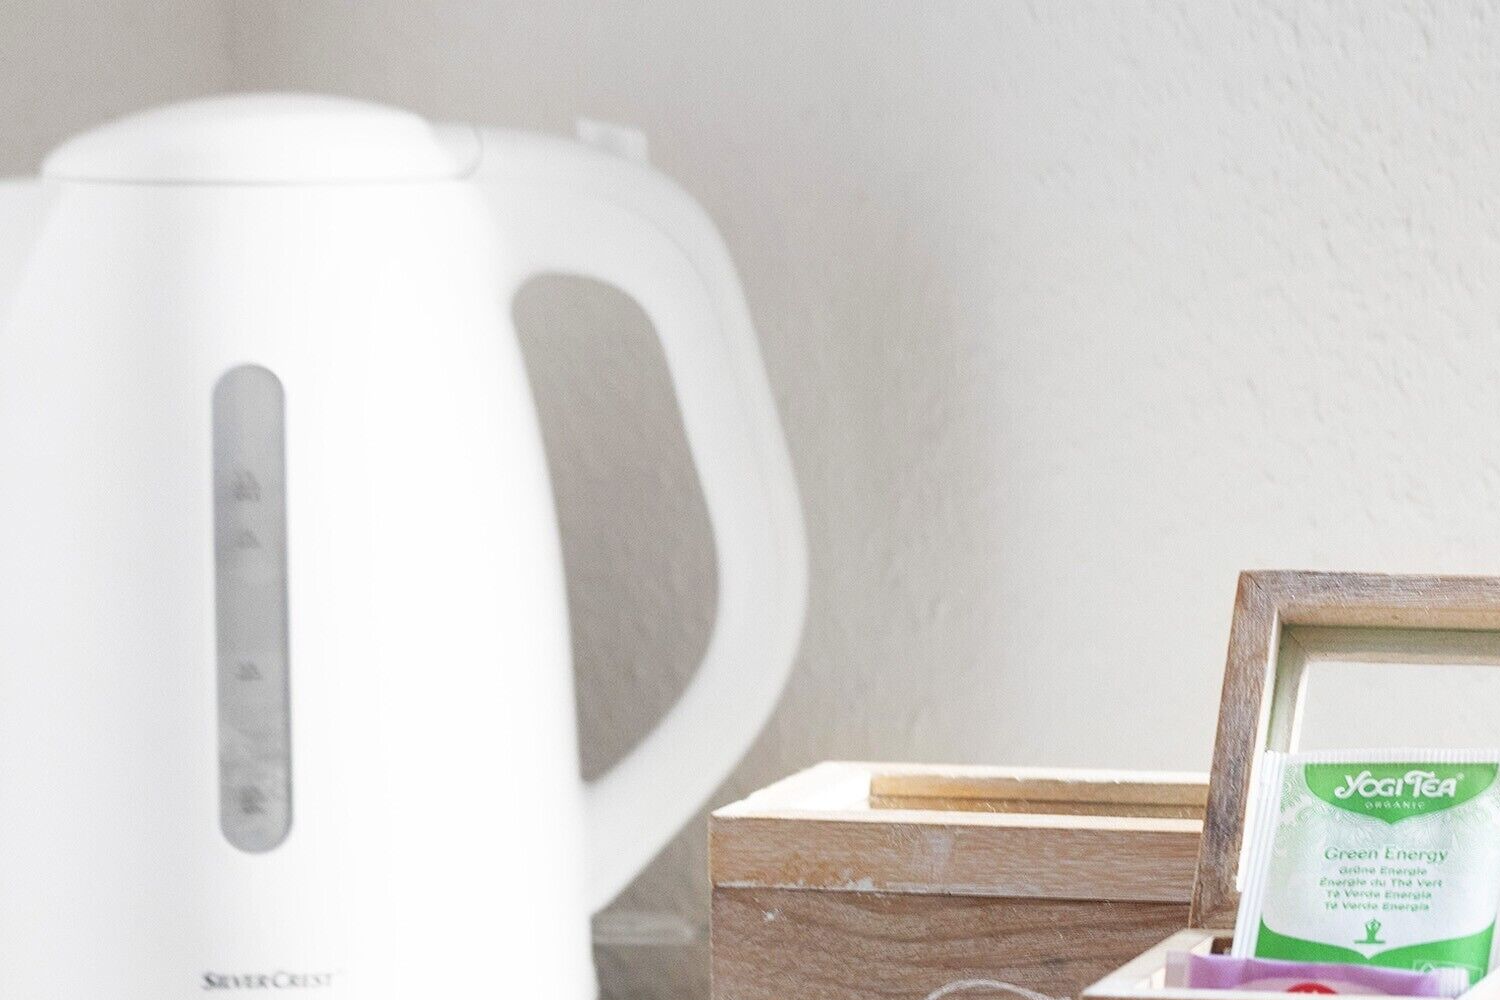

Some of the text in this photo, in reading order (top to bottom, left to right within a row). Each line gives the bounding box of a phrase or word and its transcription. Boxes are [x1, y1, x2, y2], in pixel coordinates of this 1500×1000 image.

[1334, 770, 1456, 799] YOGI TEA
[1364, 800, 1425, 809] ORGANIC
[1324, 847, 1448, 865] Green Energy
[1380, 866, 1428, 877] Energie
[1370, 878, 1386, 888] du
[1417, 878, 1443, 888] Vert
[1344, 889, 1380, 899] Verde
[1342, 901, 1378, 911] Verde
